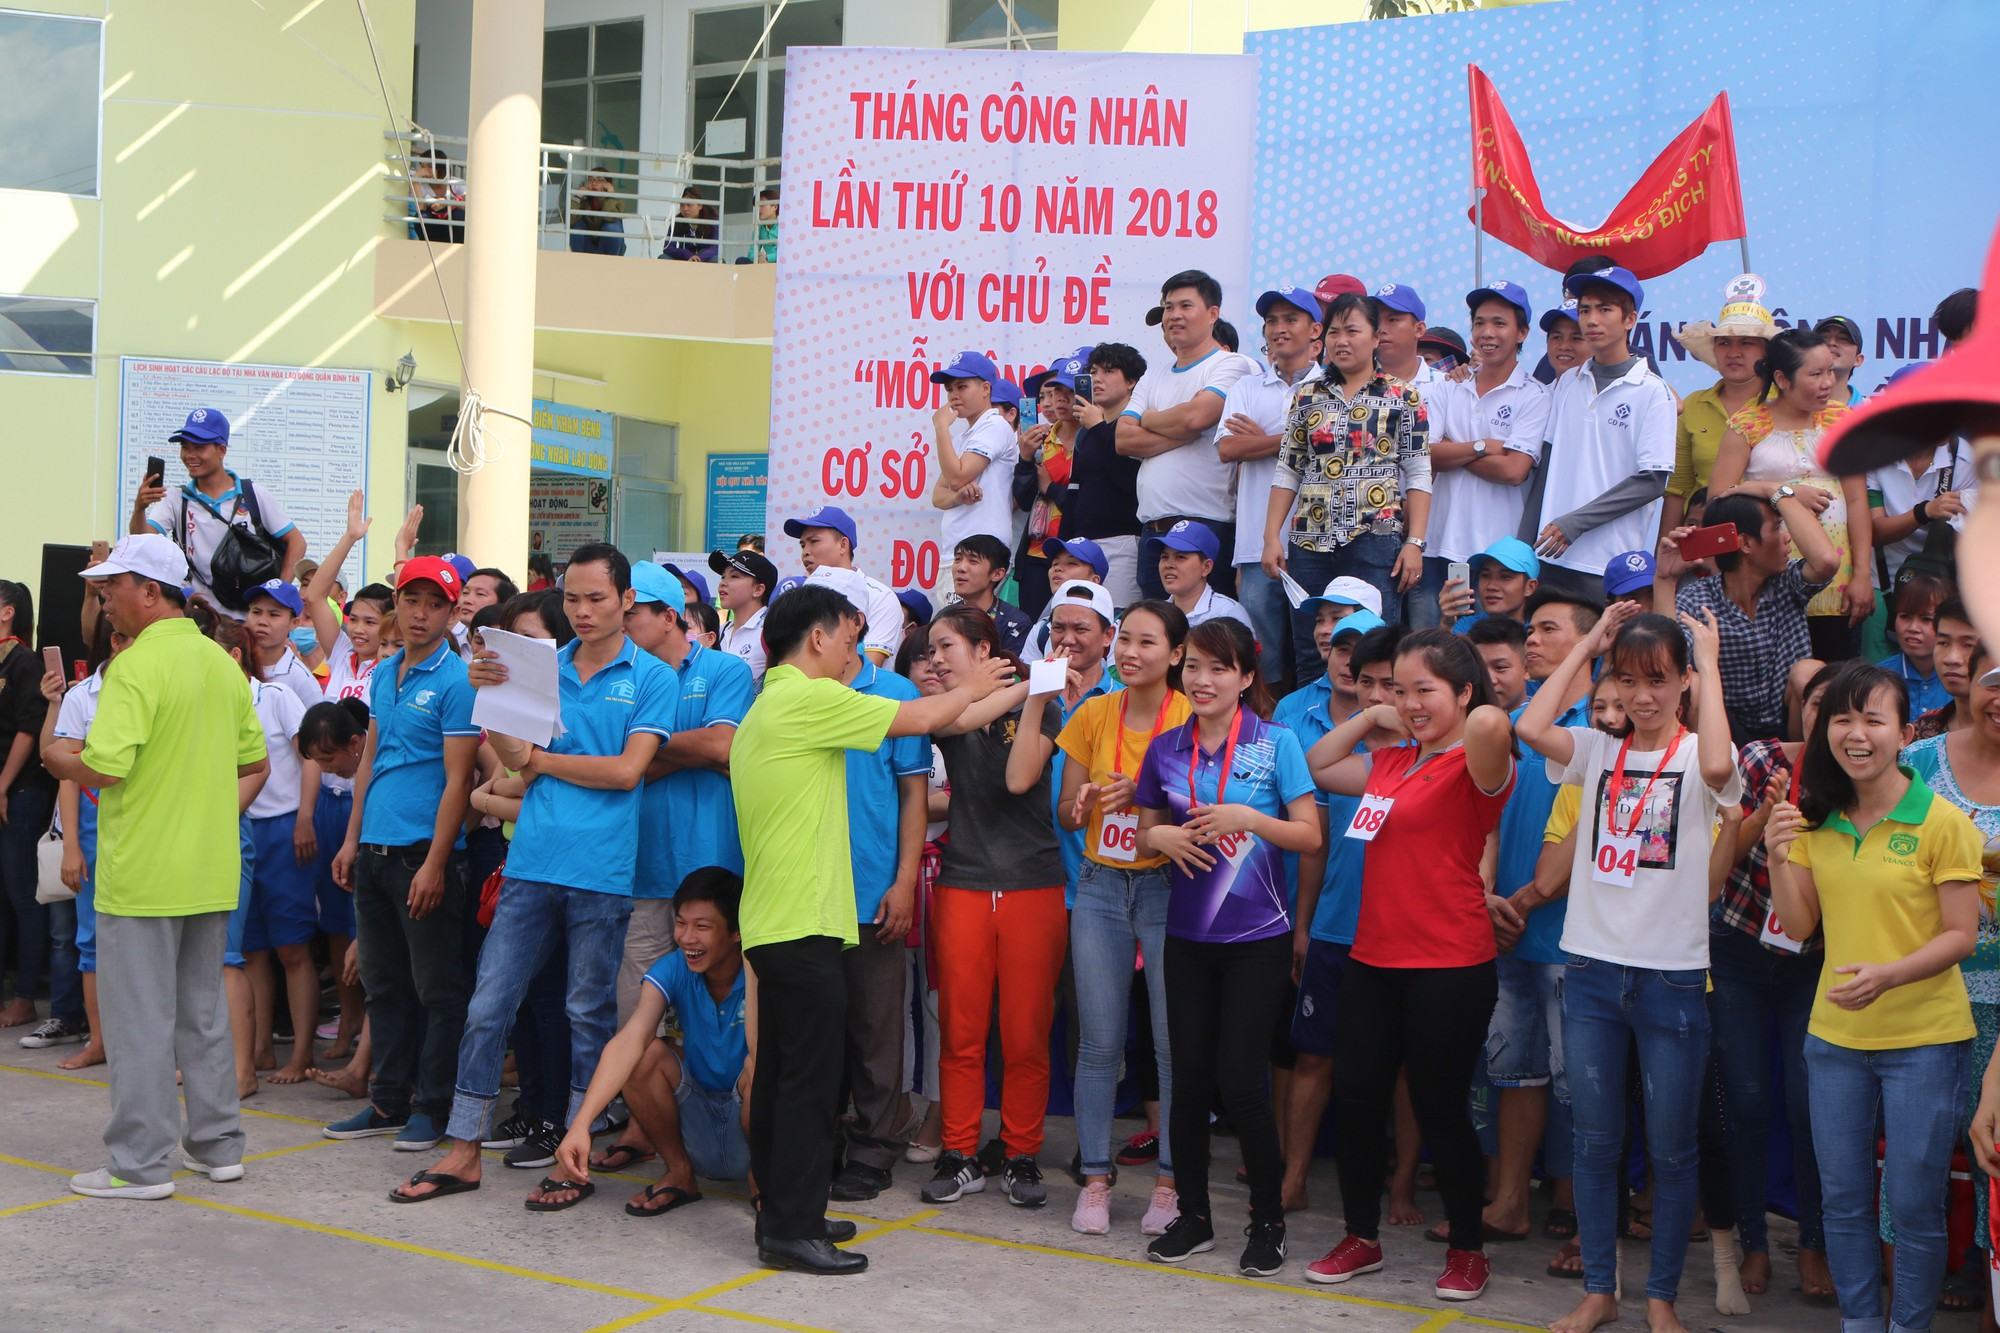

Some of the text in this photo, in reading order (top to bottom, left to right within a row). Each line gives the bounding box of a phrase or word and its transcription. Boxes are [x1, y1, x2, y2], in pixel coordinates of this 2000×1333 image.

[850, 80, 1187, 147] THÁNG CÔNG NHÂN
[1689, 144, 1714, 173] TY
[812, 159, 1218, 239] LẦN THỨ 10 NĂM 2018
[1657, 180, 1706, 229] ĐỊCH
[907, 255, 1112, 325] VỚI CHỦ ĐỀ
[1876, 317, 1948, 359] NH
[133, 363, 147, 373] LỊCH
[149, 364, 163, 372] SINH
[164, 364, 180, 374] HOẠT
[182, 364, 195, 374] CÁC
[196, 365, 208, 375] CÂU
[209, 366, 221, 376] LẠC
[222, 366, 231, 377] BỘ
[233, 368, 242, 377] TẠI
[244, 368, 256, 377] NHÀ
[258, 369, 270, 378] VĂN
[333, 372, 346, 382] BÌNH
[348, 373, 360, 383] TÂN
[556, 413, 579, 435] KHÁM
[581, 416, 601, 442] BỆNH
[530, 440, 608, 474] ÔNG NHÂN LAO ĐỘNG
[822, 432, 930, 500] CƠ SỞ
[728, 476, 740, 488] QUY
[742, 474, 754, 486] NHÀ
[549, 497, 569, 511] ĐỘNG
[891, 540, 940, 590] ĐO
[340, 685, 365, 700] 08
[1353, 807, 1386, 832] 08
[1103, 824, 1137, 851] 06
[1218, 830, 1248, 858] 04
[1598, 845, 1636, 877] 04
[1883, 856, 1916, 867] VIANCO
